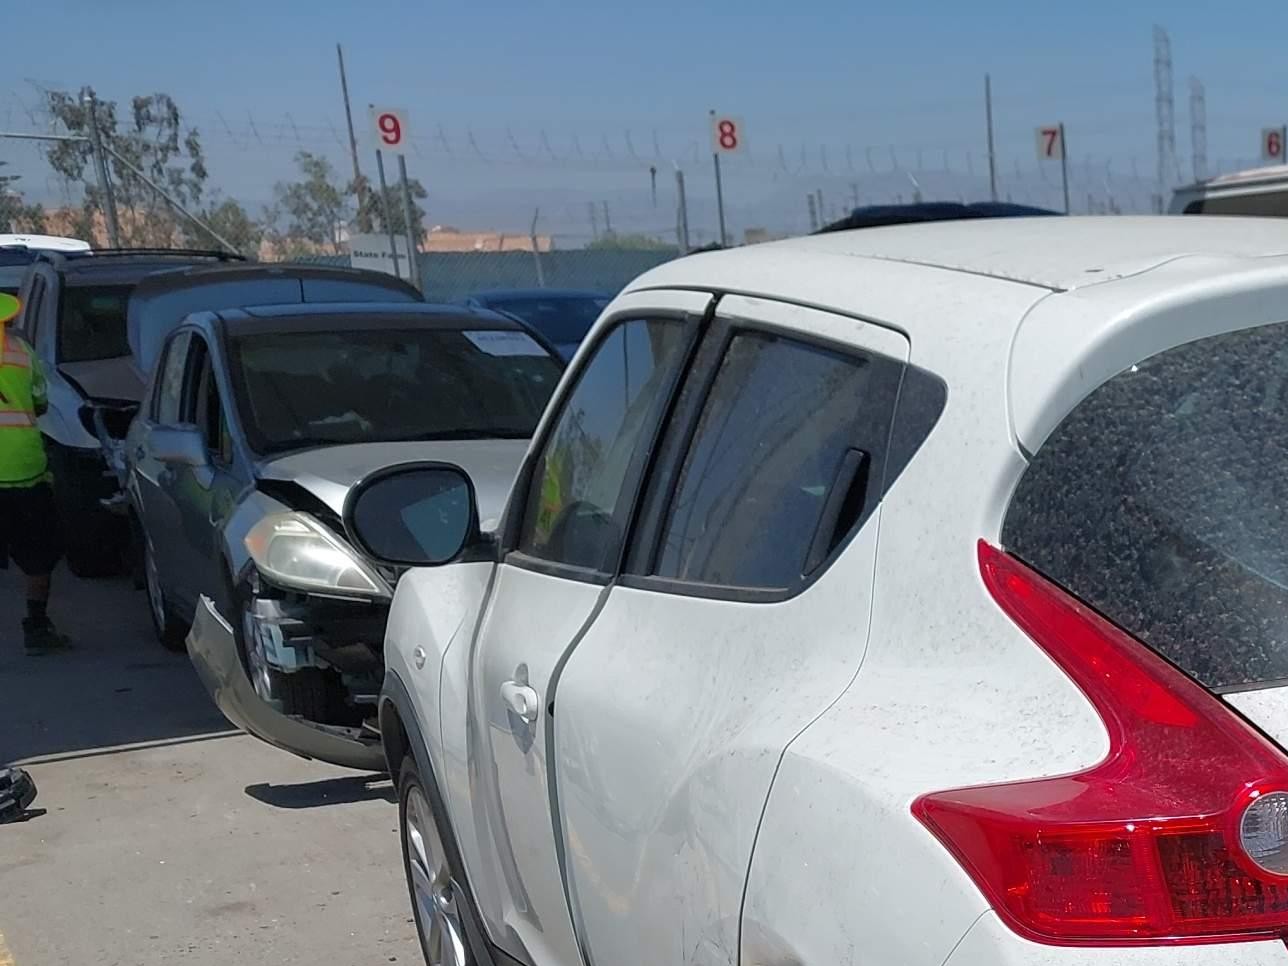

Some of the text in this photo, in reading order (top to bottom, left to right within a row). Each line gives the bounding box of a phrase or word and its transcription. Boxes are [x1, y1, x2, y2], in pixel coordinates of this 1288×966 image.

[378, 113, 402, 145] 9
[718, 119, 737, 150] 8
[1041, 129, 1057, 157] 7
[1267, 131, 1281, 158] 6
[381, 251, 407, 260] Fam
